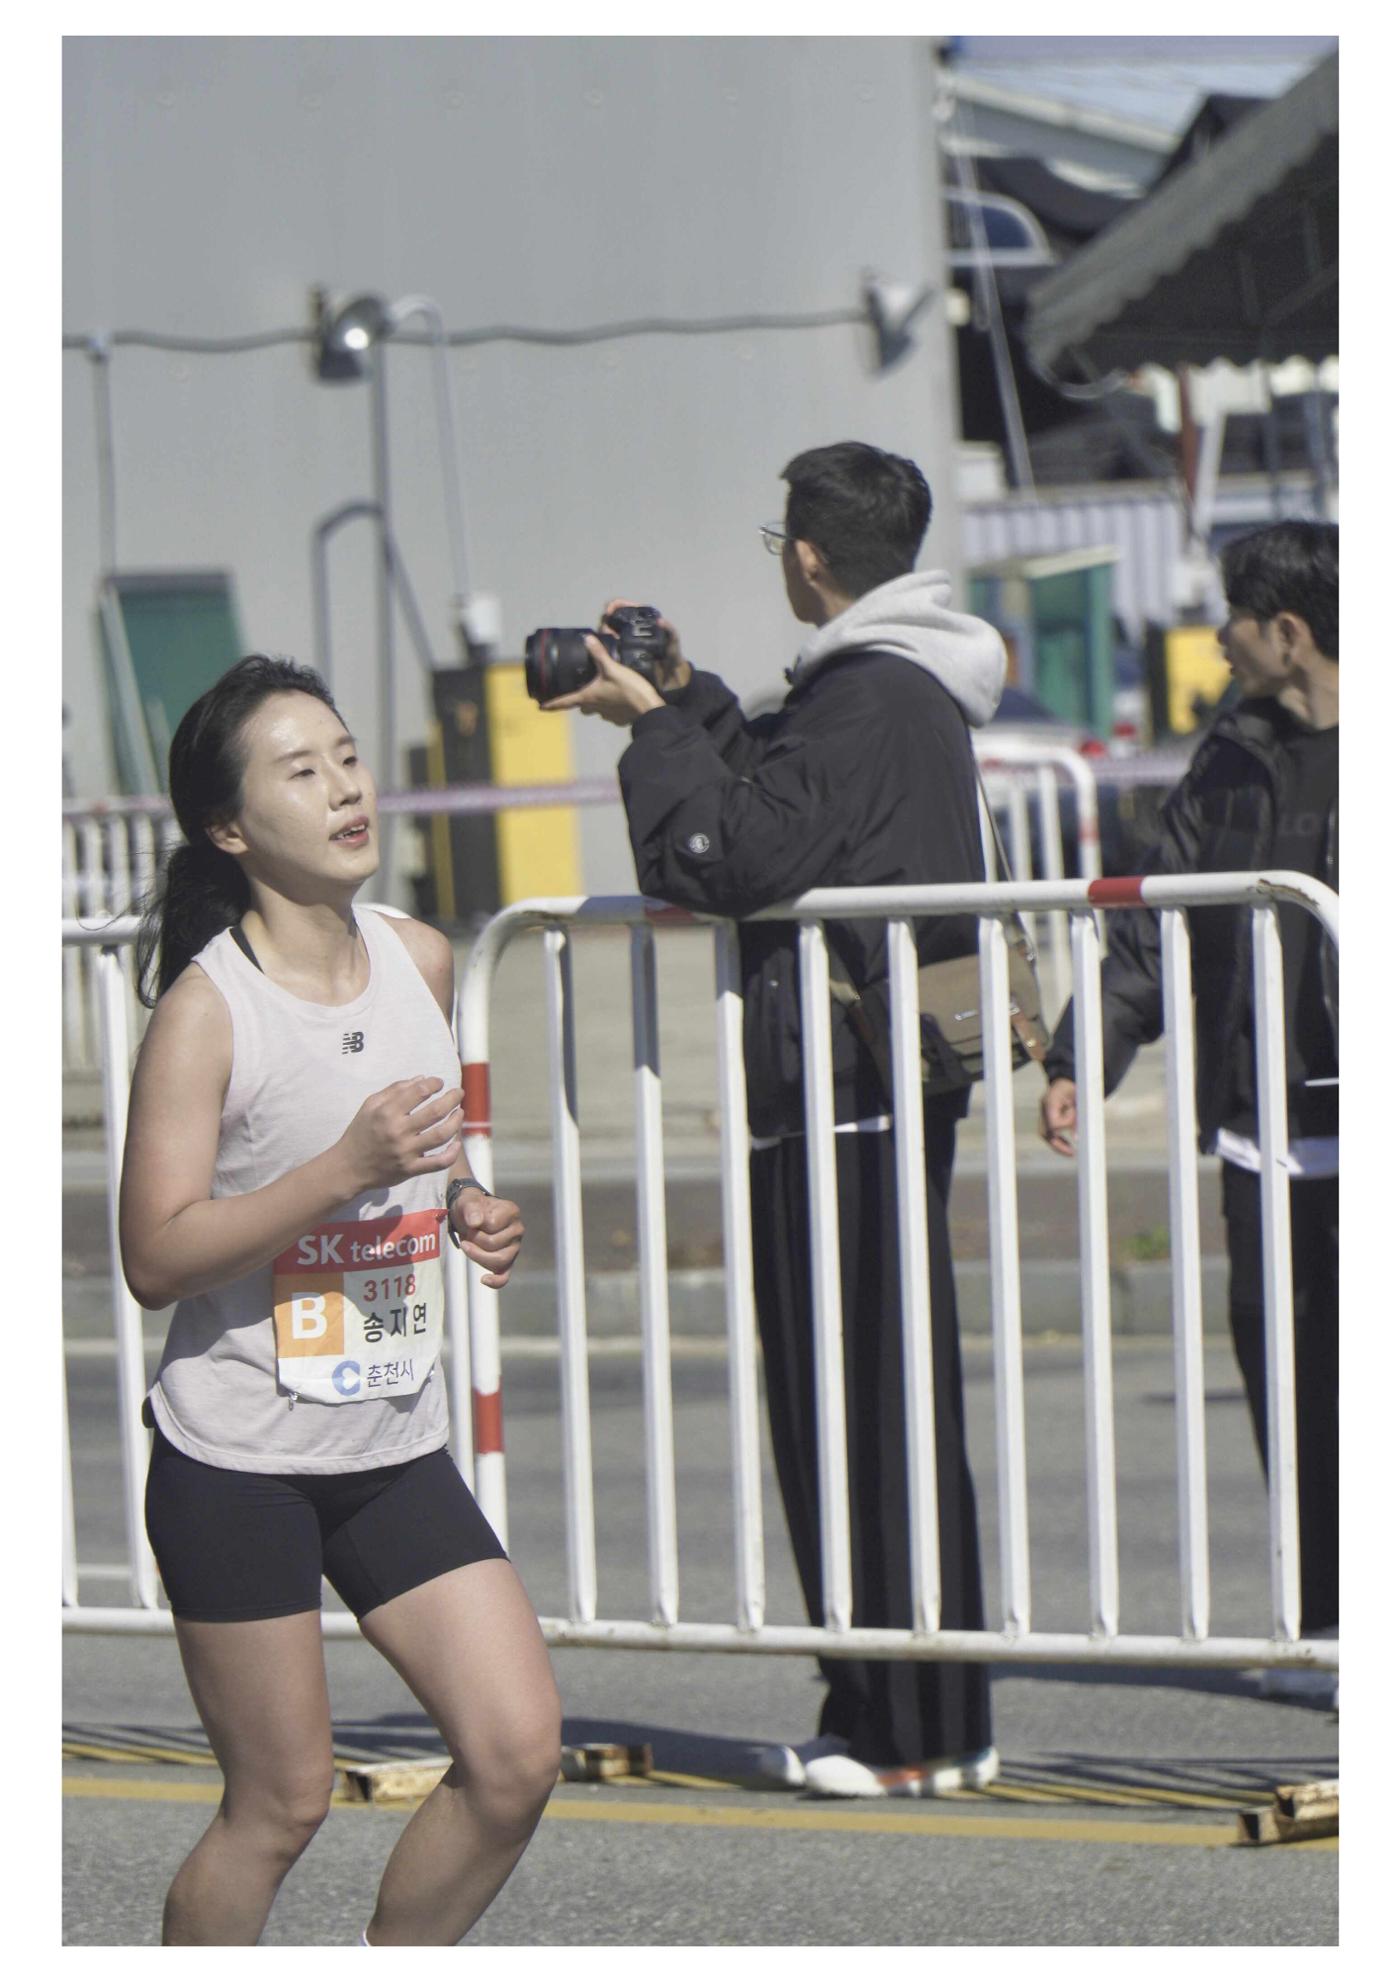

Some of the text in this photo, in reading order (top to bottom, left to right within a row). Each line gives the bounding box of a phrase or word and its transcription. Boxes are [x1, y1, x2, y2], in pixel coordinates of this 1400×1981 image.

[296, 1232, 436, 1266] SK telecom
[363, 1273, 416, 1302] 3118
[291, 1292, 328, 1340] B
[363, 1302, 428, 1343] 송지연
[366, 1358, 415, 1388] 춘천시
